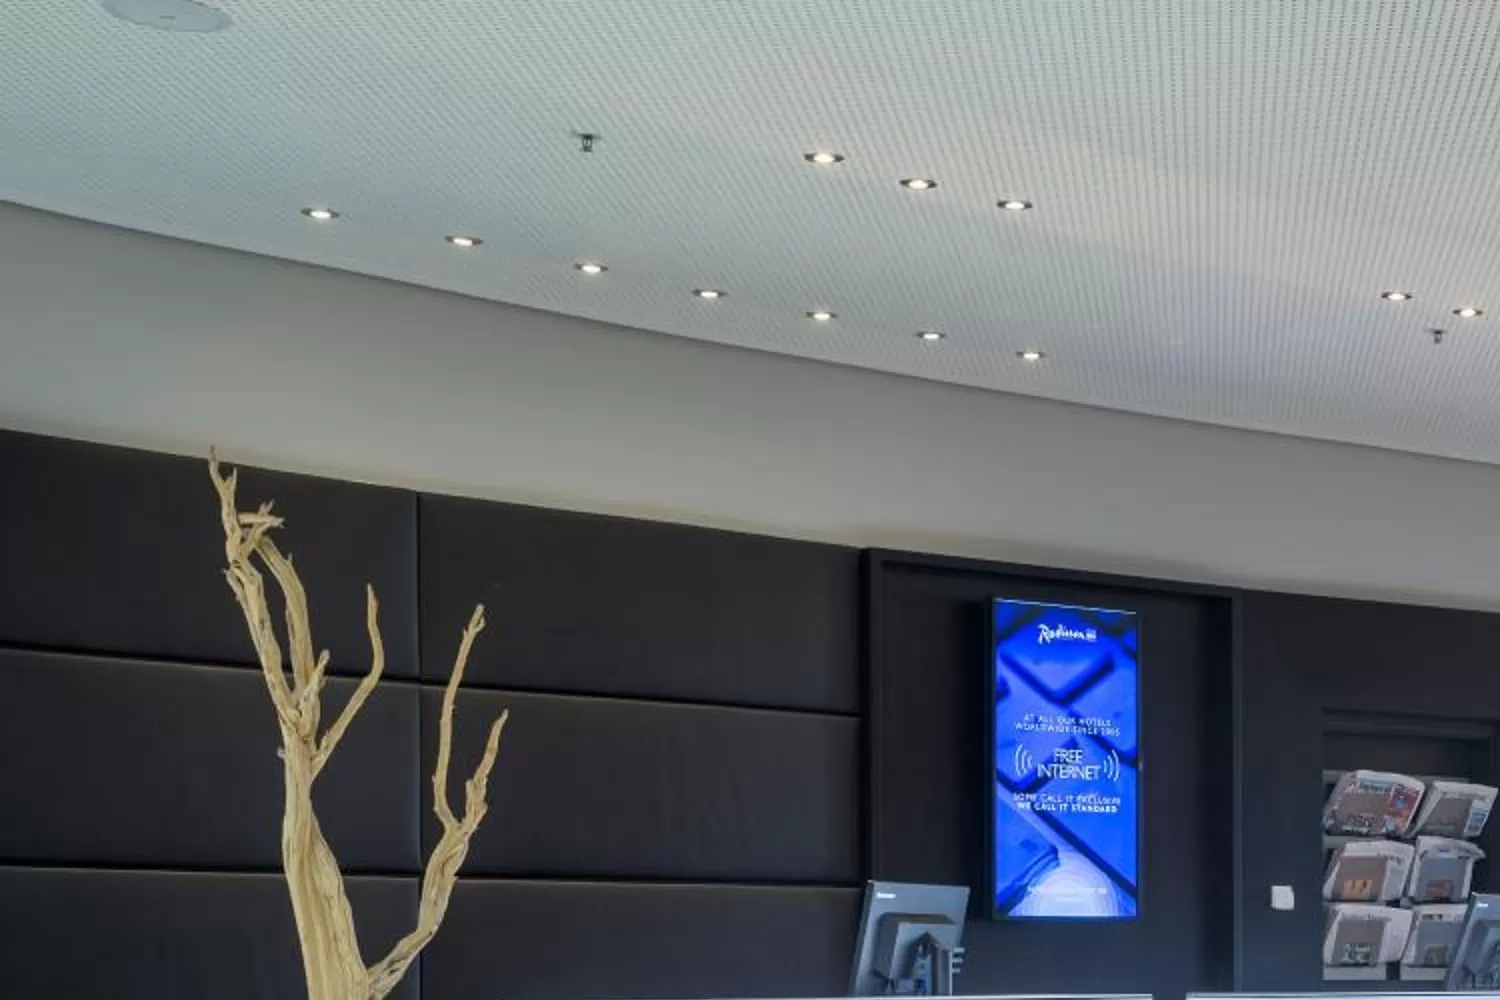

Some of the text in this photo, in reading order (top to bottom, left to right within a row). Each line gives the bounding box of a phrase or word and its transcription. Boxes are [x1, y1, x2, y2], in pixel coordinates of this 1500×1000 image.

[1054, 748, 1083, 763] FREE
[1037, 764, 1101, 780] INTERNET
[1034, 802, 1057, 810] CALL
[1071, 804, 1118, 813] STANDARD
